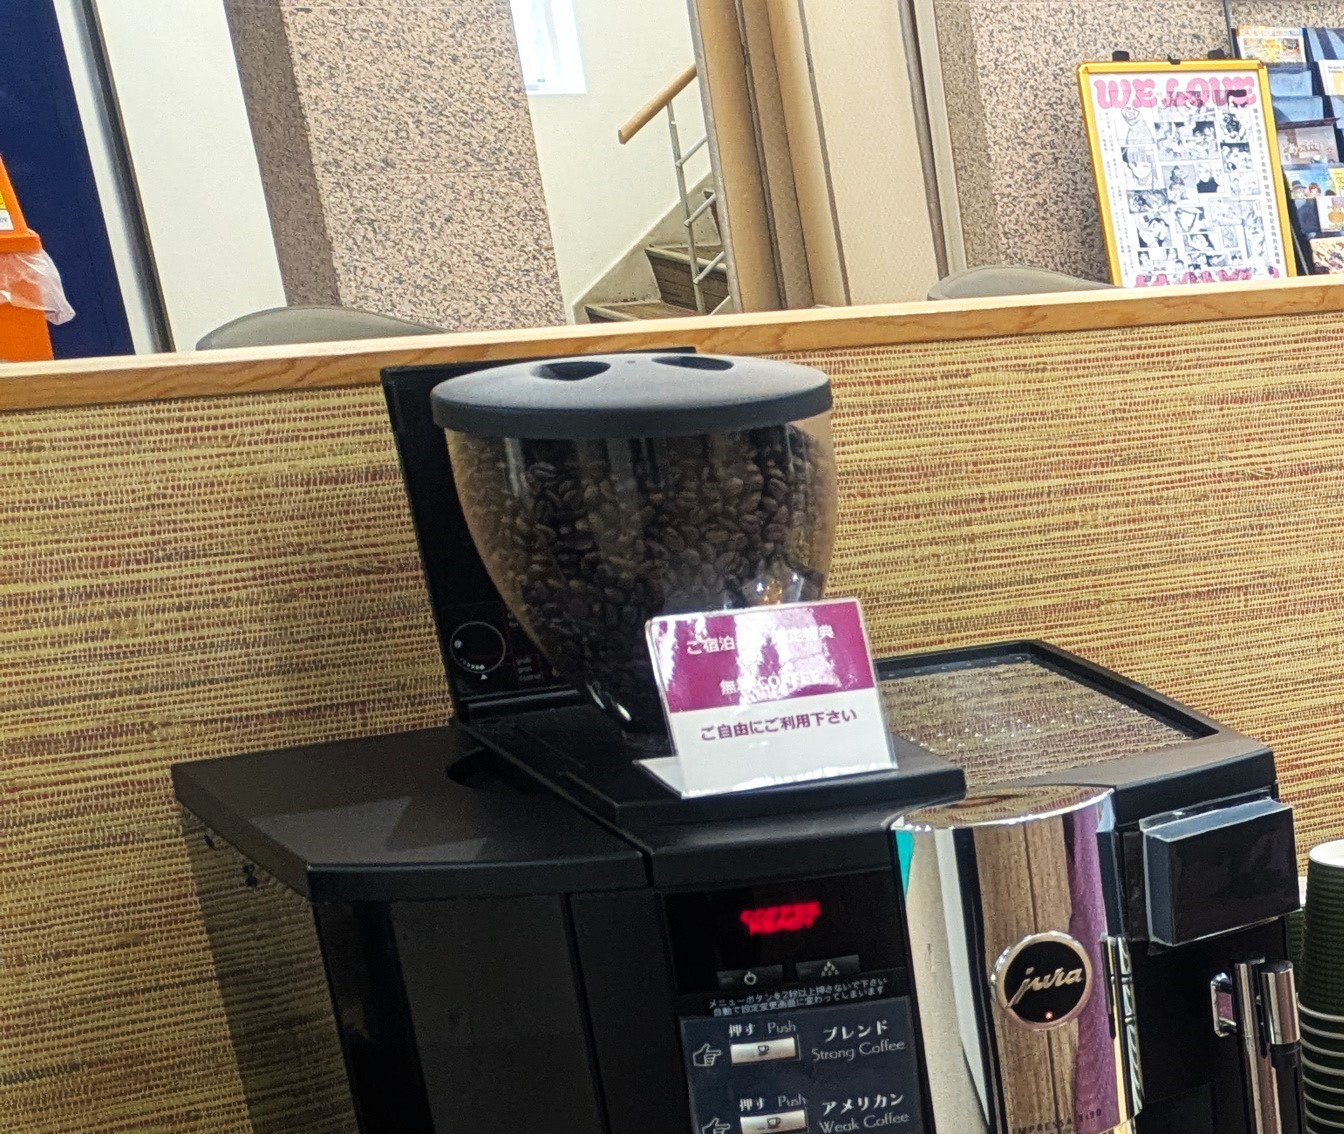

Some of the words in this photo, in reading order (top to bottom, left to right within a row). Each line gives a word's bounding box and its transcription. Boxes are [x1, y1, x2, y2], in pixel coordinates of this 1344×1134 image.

[1094, 78, 1158, 109] WE
[1162, 76, 1257, 108] LOVE
[700, 708, 858, 741] ご自由にご利用下さい
[1007, 966, 1083, 1009] jura
[729, 1022, 755, 1038] 押す
[767, 1021, 797, 1035] Push
[823, 1019, 889, 1042] ブレンド
[811, 1047, 855, 1062] Strong
[858, 1039, 906, 1056] Coffee
[740, 1097, 766, 1112] 押す
[777, 1093, 807, 1108] Push
[821, 1092, 904, 1116] アメリカン
[819, 1119, 860, 1134] Weak
[863, 1111, 910, 1129] Coffee
